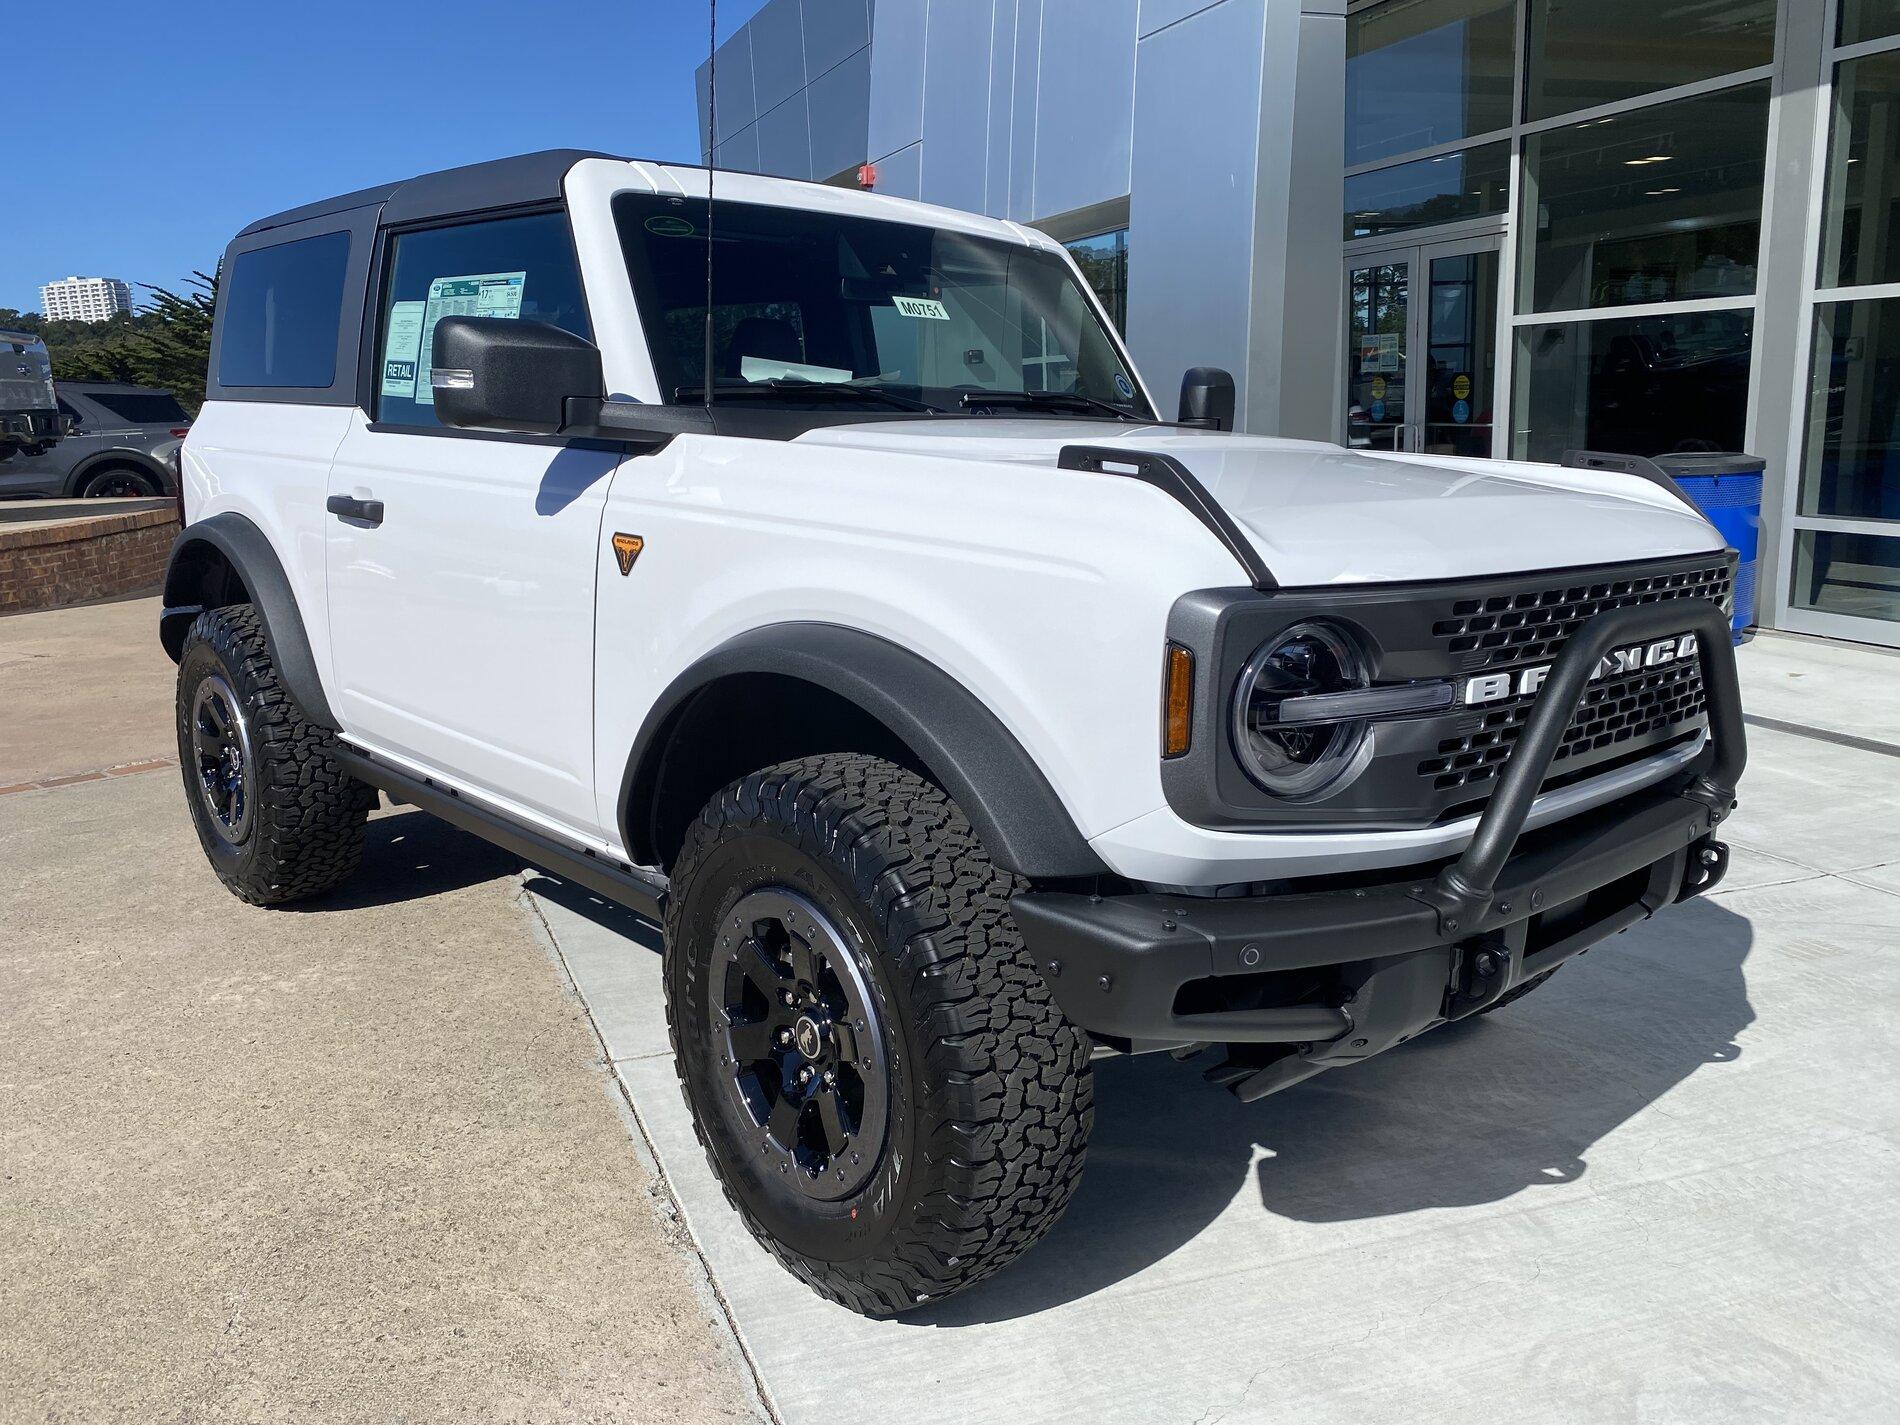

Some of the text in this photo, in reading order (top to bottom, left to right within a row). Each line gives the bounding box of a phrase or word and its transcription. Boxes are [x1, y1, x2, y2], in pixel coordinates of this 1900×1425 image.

[901, 302, 943, 317] M0751
[387, 364, 412, 378] RETAIL
[1465, 635, 1698, 705] BRNCO
